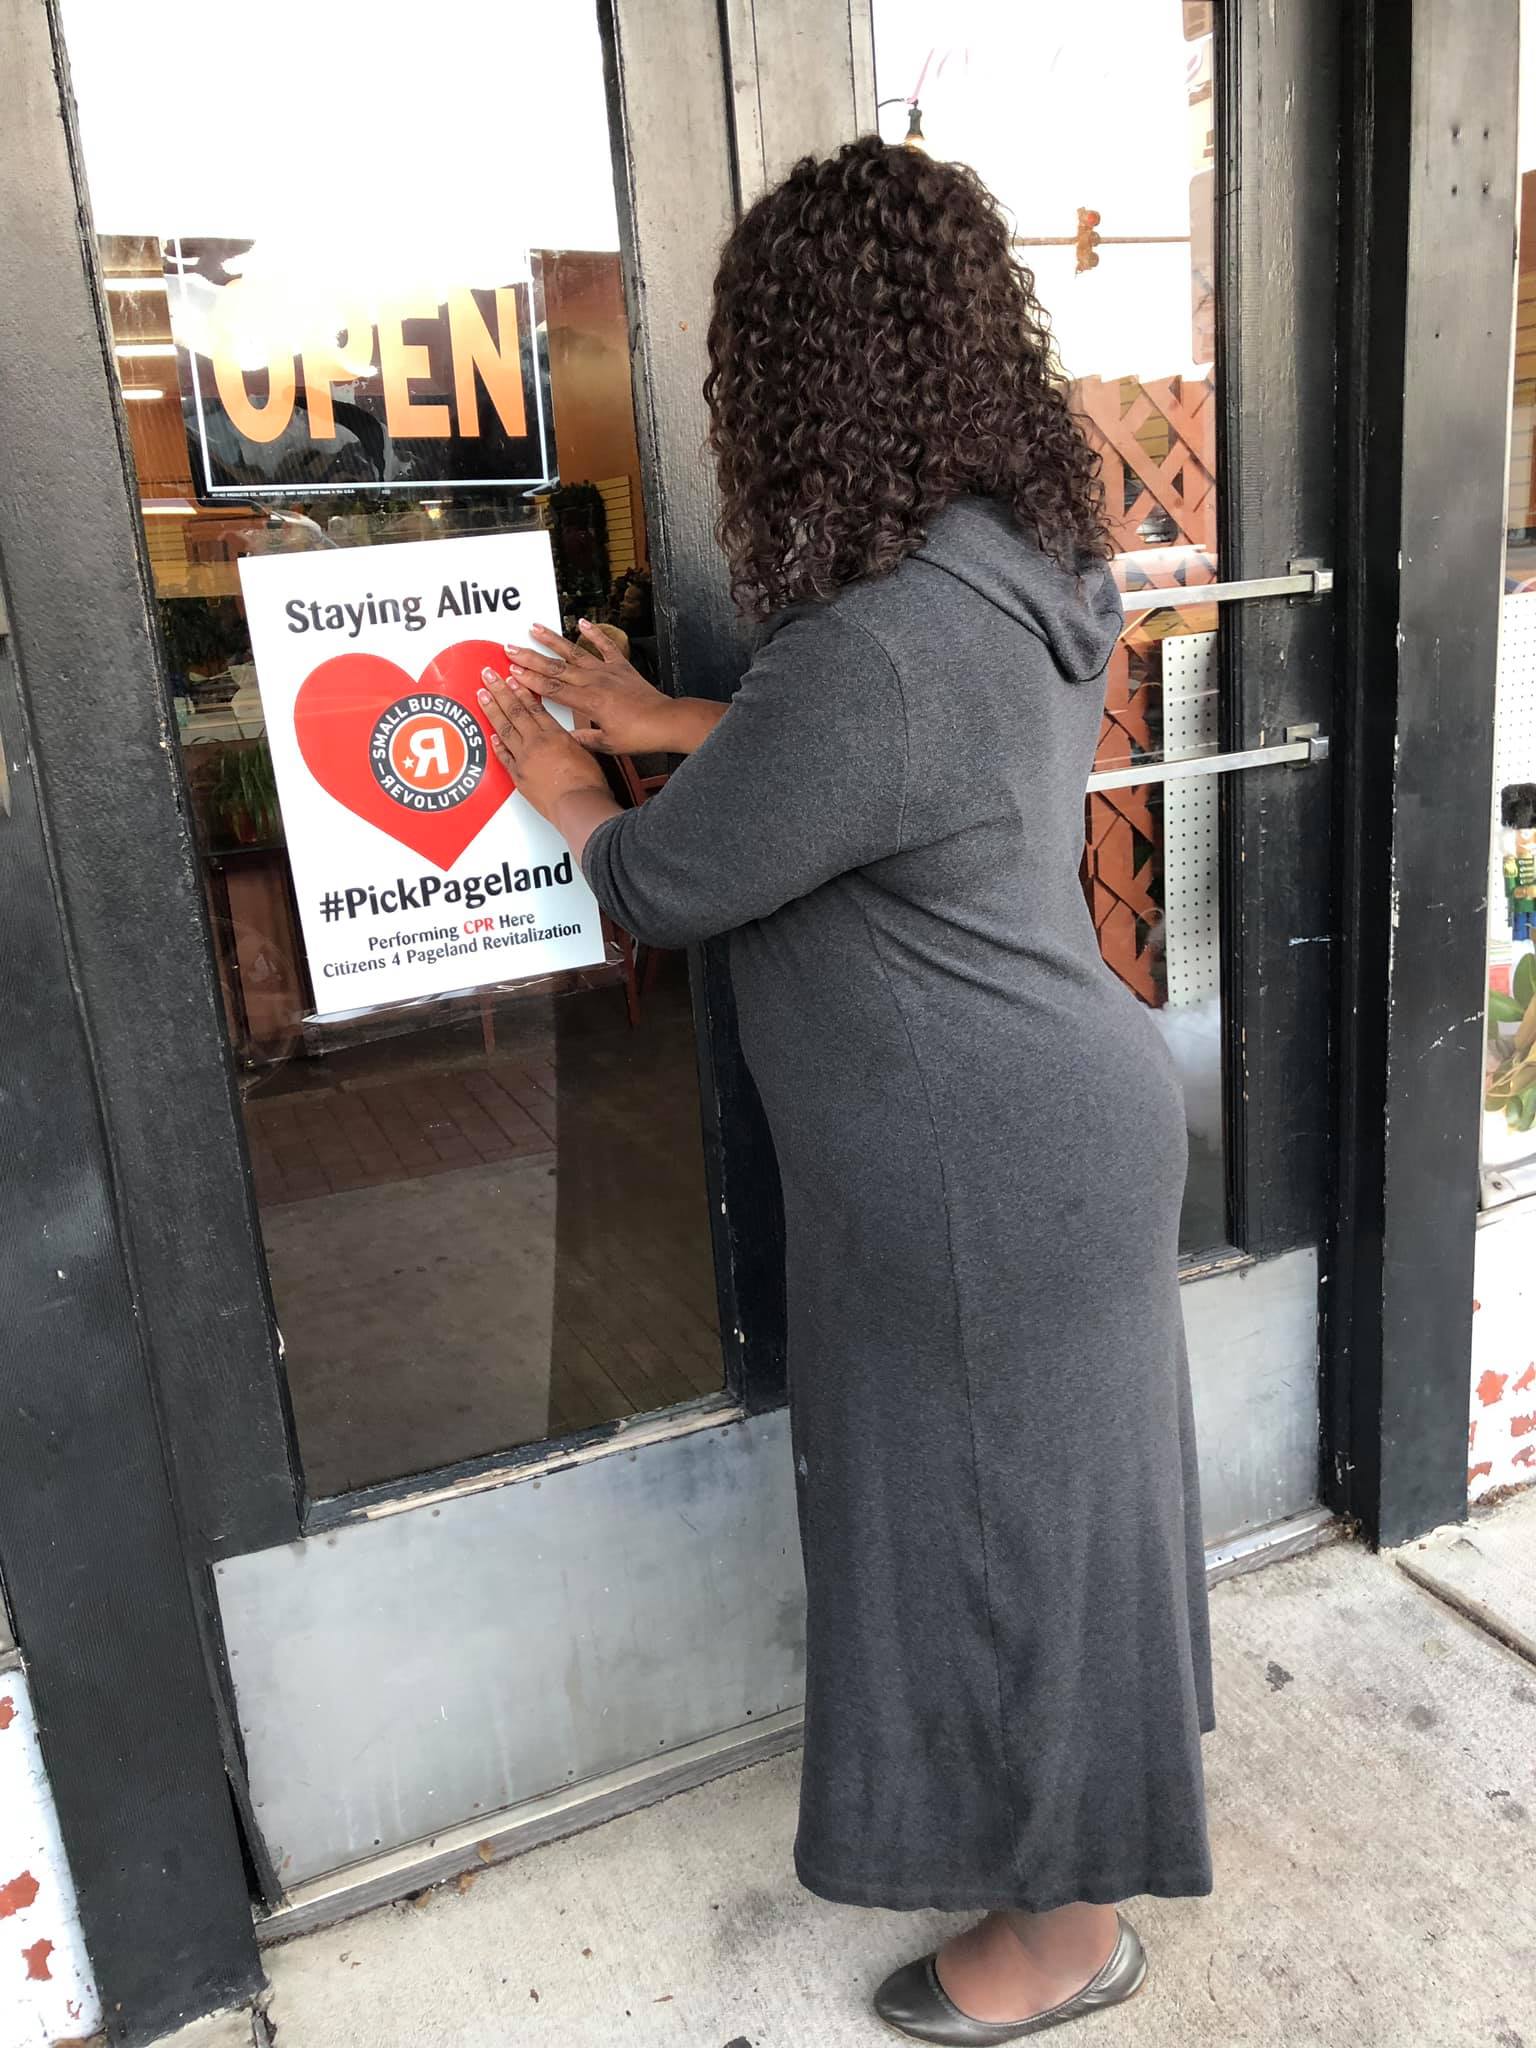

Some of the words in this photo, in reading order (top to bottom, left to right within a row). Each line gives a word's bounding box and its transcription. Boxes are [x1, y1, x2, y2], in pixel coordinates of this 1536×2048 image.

[213, 278, 527, 443] OPEN
[285, 593, 427, 638] Staying
[437, 580, 521, 618] Alive
[372, 706, 408, 759] SMALL
[408, 696, 482, 747] BUSINESS
[319, 852, 573, 922] #PickPageland
[323, 958, 387, 978] Citizens
[391, 954, 401, 967] 4
[407, 942, 479, 965] Pageland
[482, 923, 582, 951] Revitalization
[368, 926, 460, 951] Performing
[463, 917, 495, 935] CPR
[499, 913, 536, 929] Here
